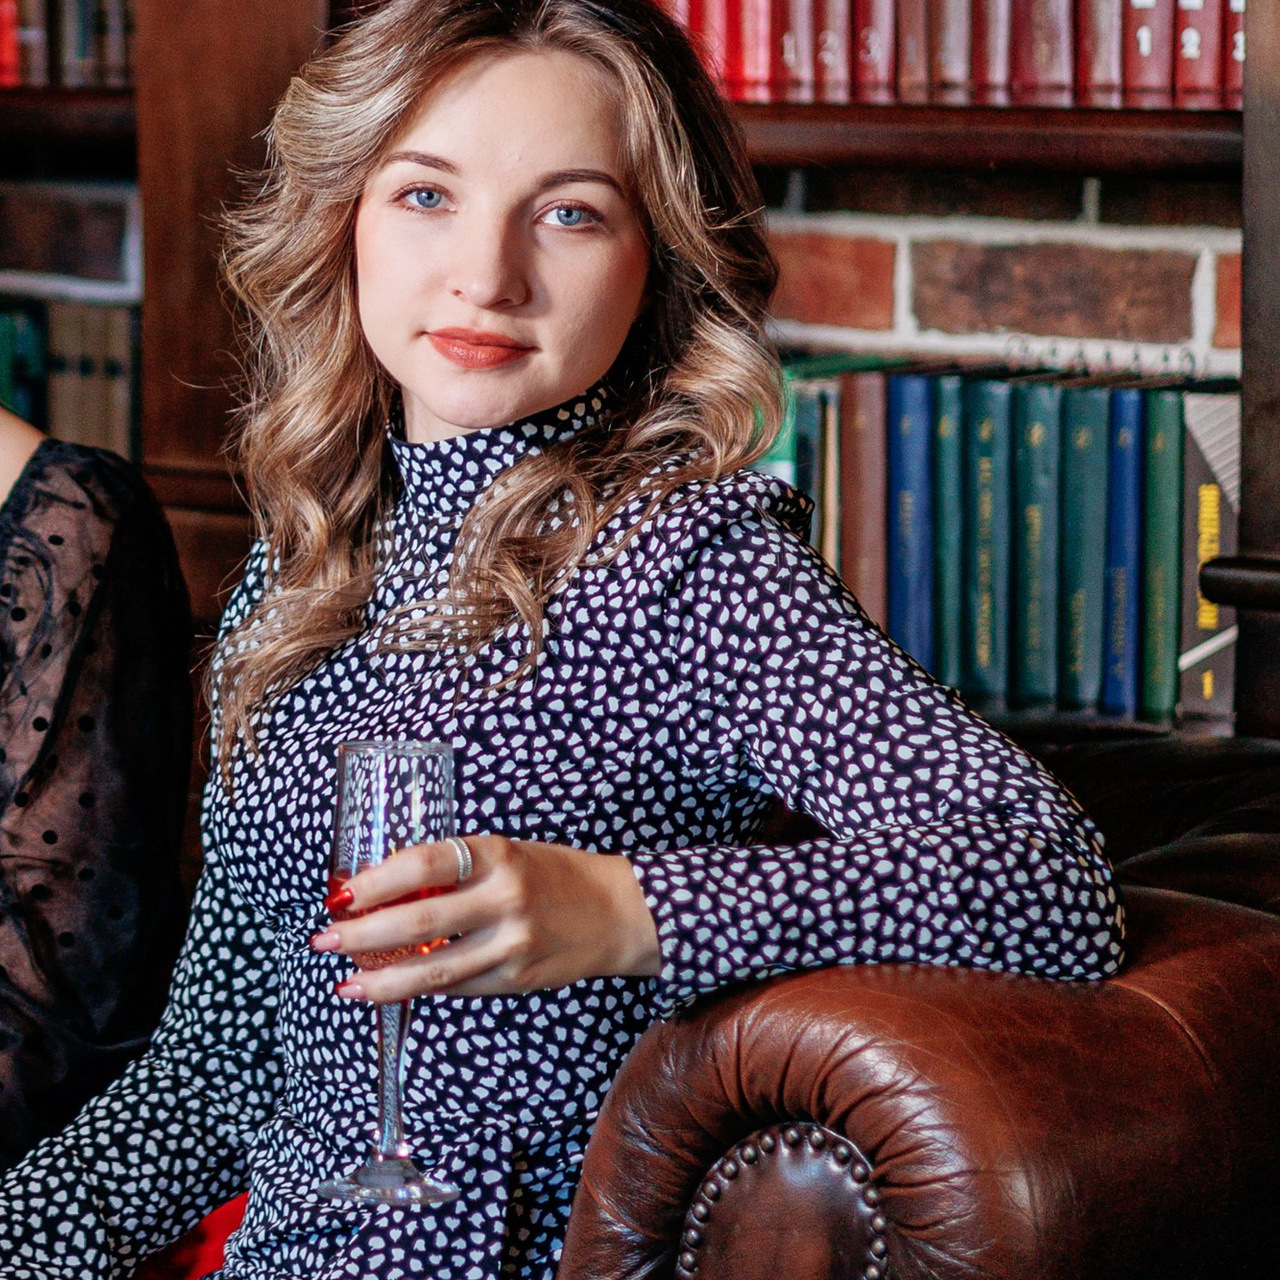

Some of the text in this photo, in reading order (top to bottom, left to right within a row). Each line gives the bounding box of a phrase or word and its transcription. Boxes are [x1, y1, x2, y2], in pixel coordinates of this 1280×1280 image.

[818, 29, 838, 67] 2
[1136, 25, 1152, 57] 1
[1181, 27, 1201, 59] 2
[1201, 669, 1214, 701] 1
